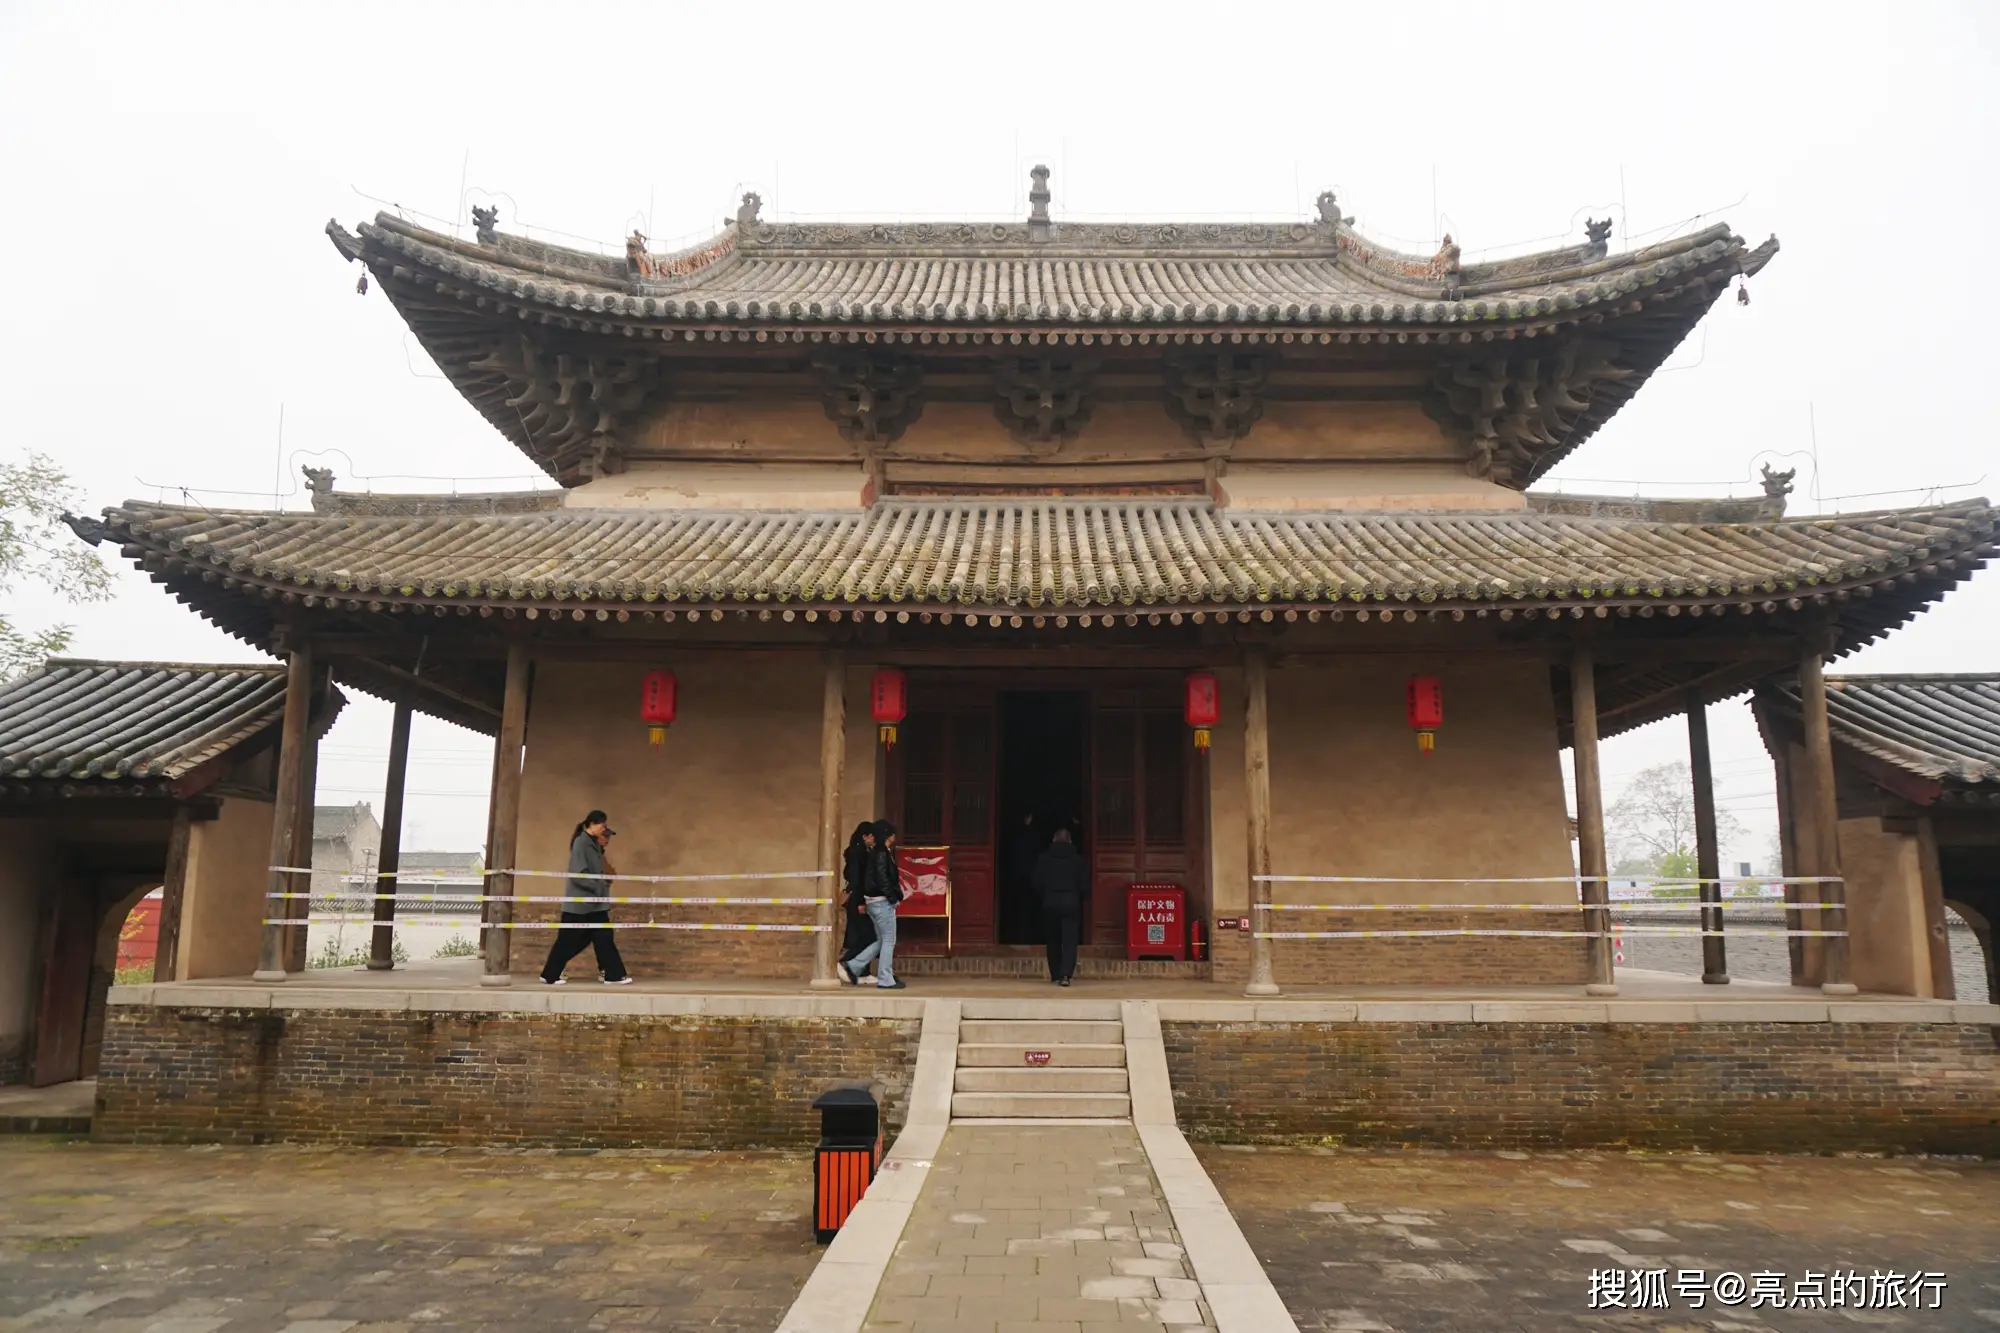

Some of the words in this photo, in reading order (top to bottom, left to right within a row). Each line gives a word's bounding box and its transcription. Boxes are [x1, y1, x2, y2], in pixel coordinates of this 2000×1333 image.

[1137, 899, 1175, 910] 保护文物
[1138, 912, 1175, 923] 人人有责
